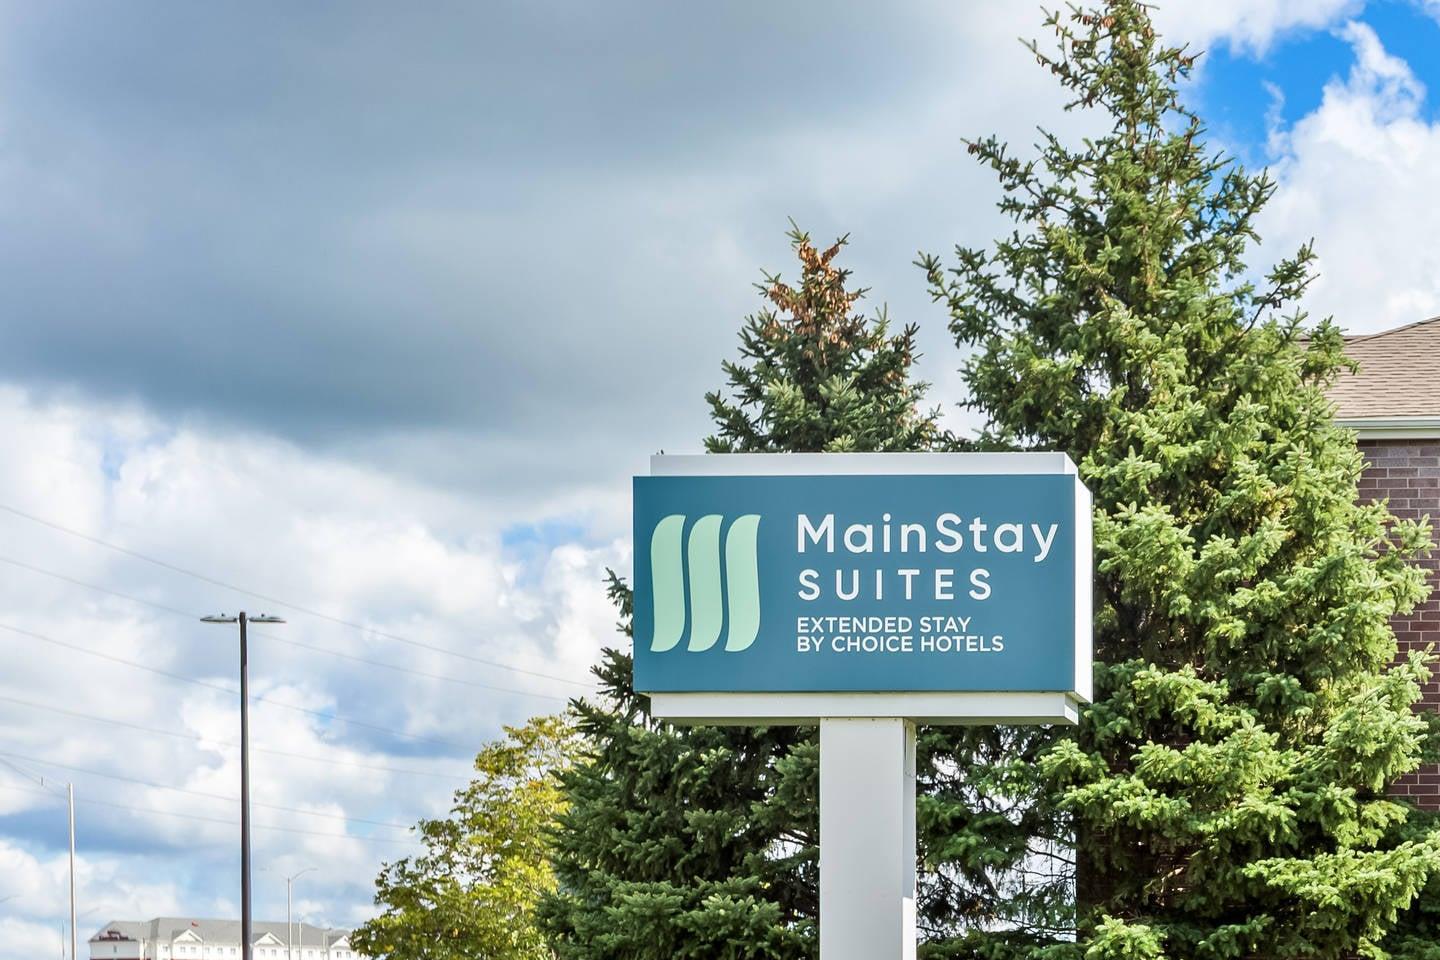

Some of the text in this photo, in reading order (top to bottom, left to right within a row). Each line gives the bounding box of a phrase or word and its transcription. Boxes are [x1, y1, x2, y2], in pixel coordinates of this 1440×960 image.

[797, 512, 1059, 563] MainStay
[798, 568, 992, 601] SUITES
[797, 616, 972, 634] EXTENDED STAY
[797, 635, 1004, 652] BY CHOICE HOTELS
